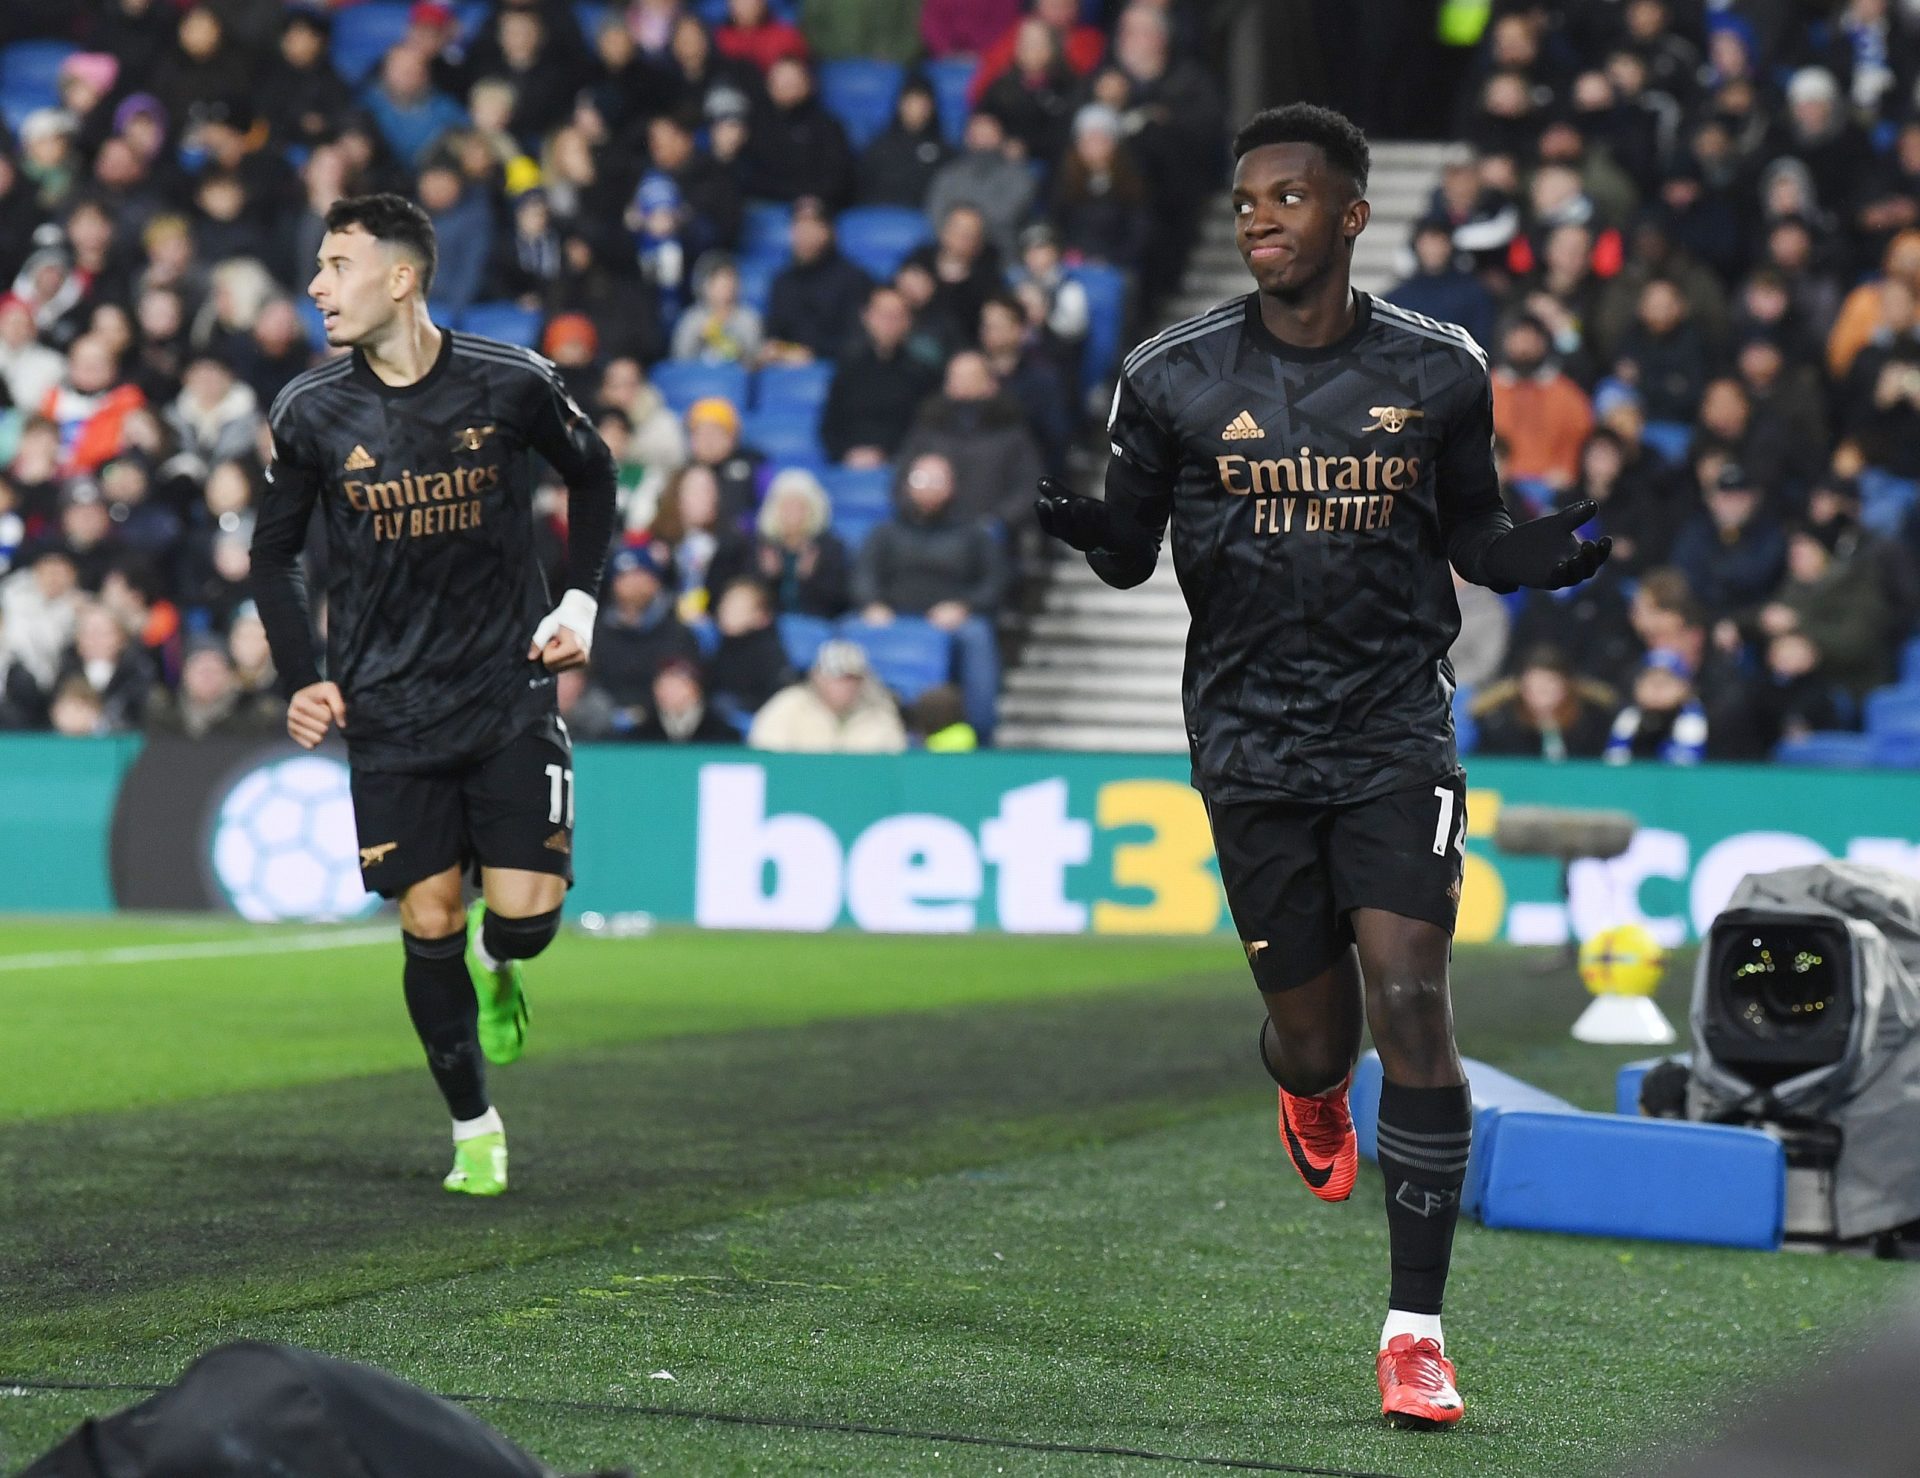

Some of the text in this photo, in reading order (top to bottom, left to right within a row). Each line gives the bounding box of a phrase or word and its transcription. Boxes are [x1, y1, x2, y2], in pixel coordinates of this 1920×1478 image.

[1221, 428, 1266, 441] adidas
[343, 463, 500, 511] Emirates
[1215, 446, 1420, 496] Emirates
[373, 500, 483, 542] FLY BETTER
[1253, 493, 1395, 534] FLY BETTER
[544, 763, 574, 830] 11
